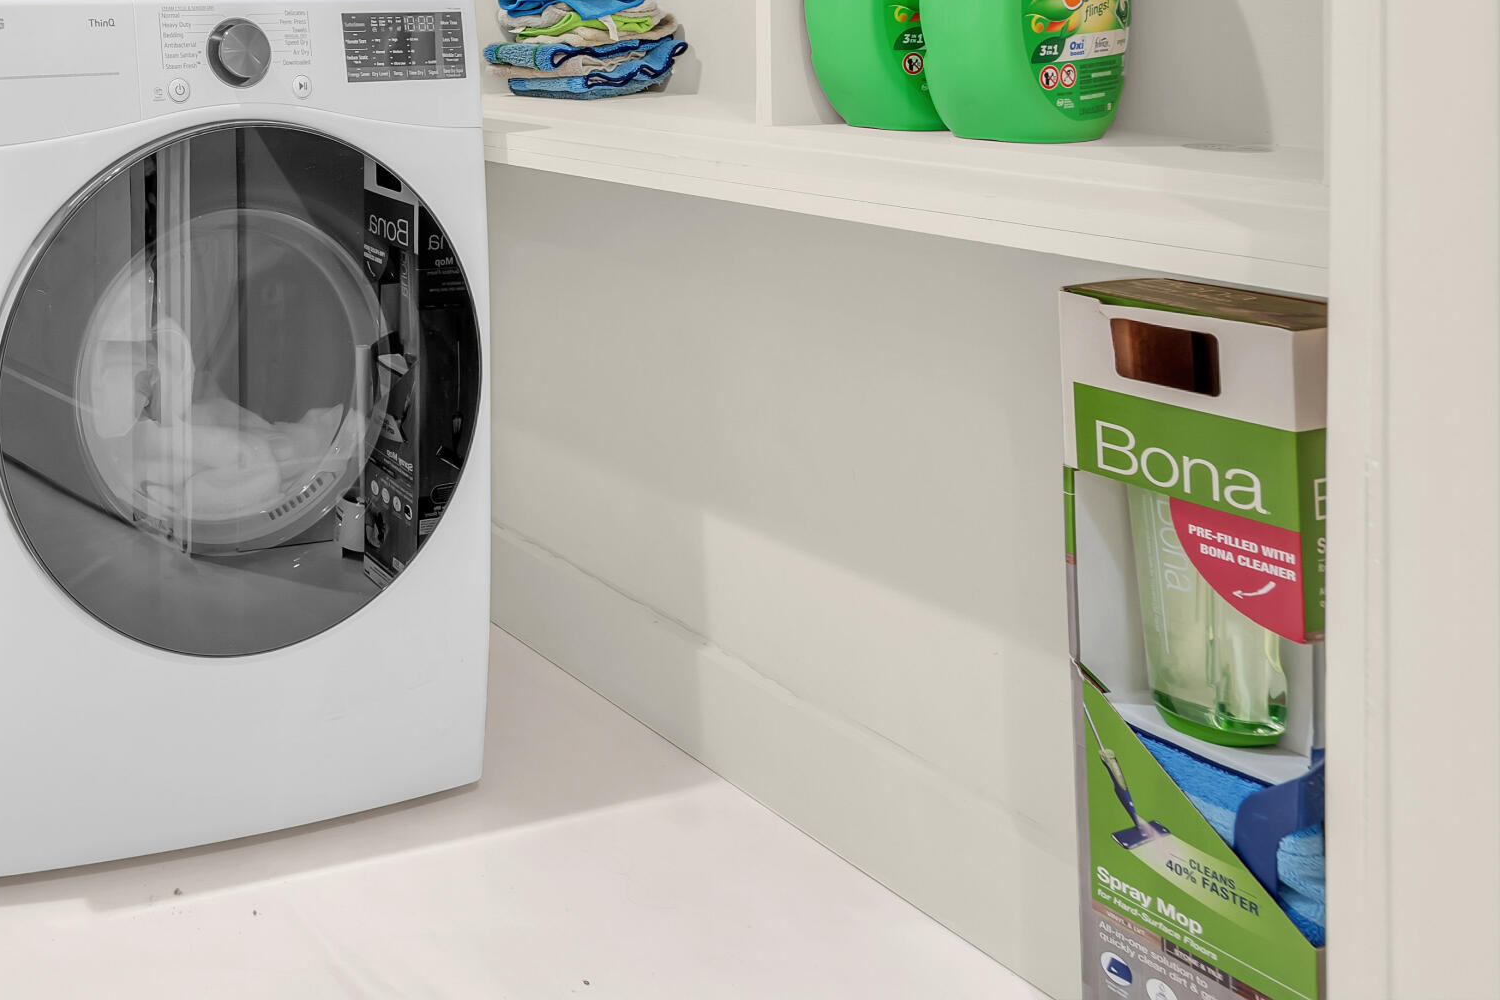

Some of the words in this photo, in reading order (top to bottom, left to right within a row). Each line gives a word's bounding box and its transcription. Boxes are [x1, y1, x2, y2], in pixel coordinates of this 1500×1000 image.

[88, 18, 115, 27] ThinQ
[1069, 39, 1085, 51] Oxi
[1095, 419, 1271, 515] Bona
[1188, 523, 1259, 554] PRE-FILLED
[1261, 545, 1296, 565] WITH
[1200, 543, 1235, 564] BONA
[1237, 555, 1297, 582] CLEANER
[1096, 865, 1152, 906] Spray
[1156, 897, 1203, 935] Mop
[1165, 859, 1197, 884] 40%
[1202, 880, 1259, 917] FASTER
[1189, 859, 1236, 890] CLEANS
[1097, 888, 1112, 901] for
[1113, 898, 1181, 940] Hard-Surface
[1183, 936, 1218, 961] Floors
[1099, 920, 1149, 954] All-in-one
[1150, 951, 1194, 980] solution
[1196, 976, 1209, 989] to
[1099, 932, 1136, 958] quickly
[1137, 954, 1167, 975] clean
[1169, 972, 1188, 988] dirt
